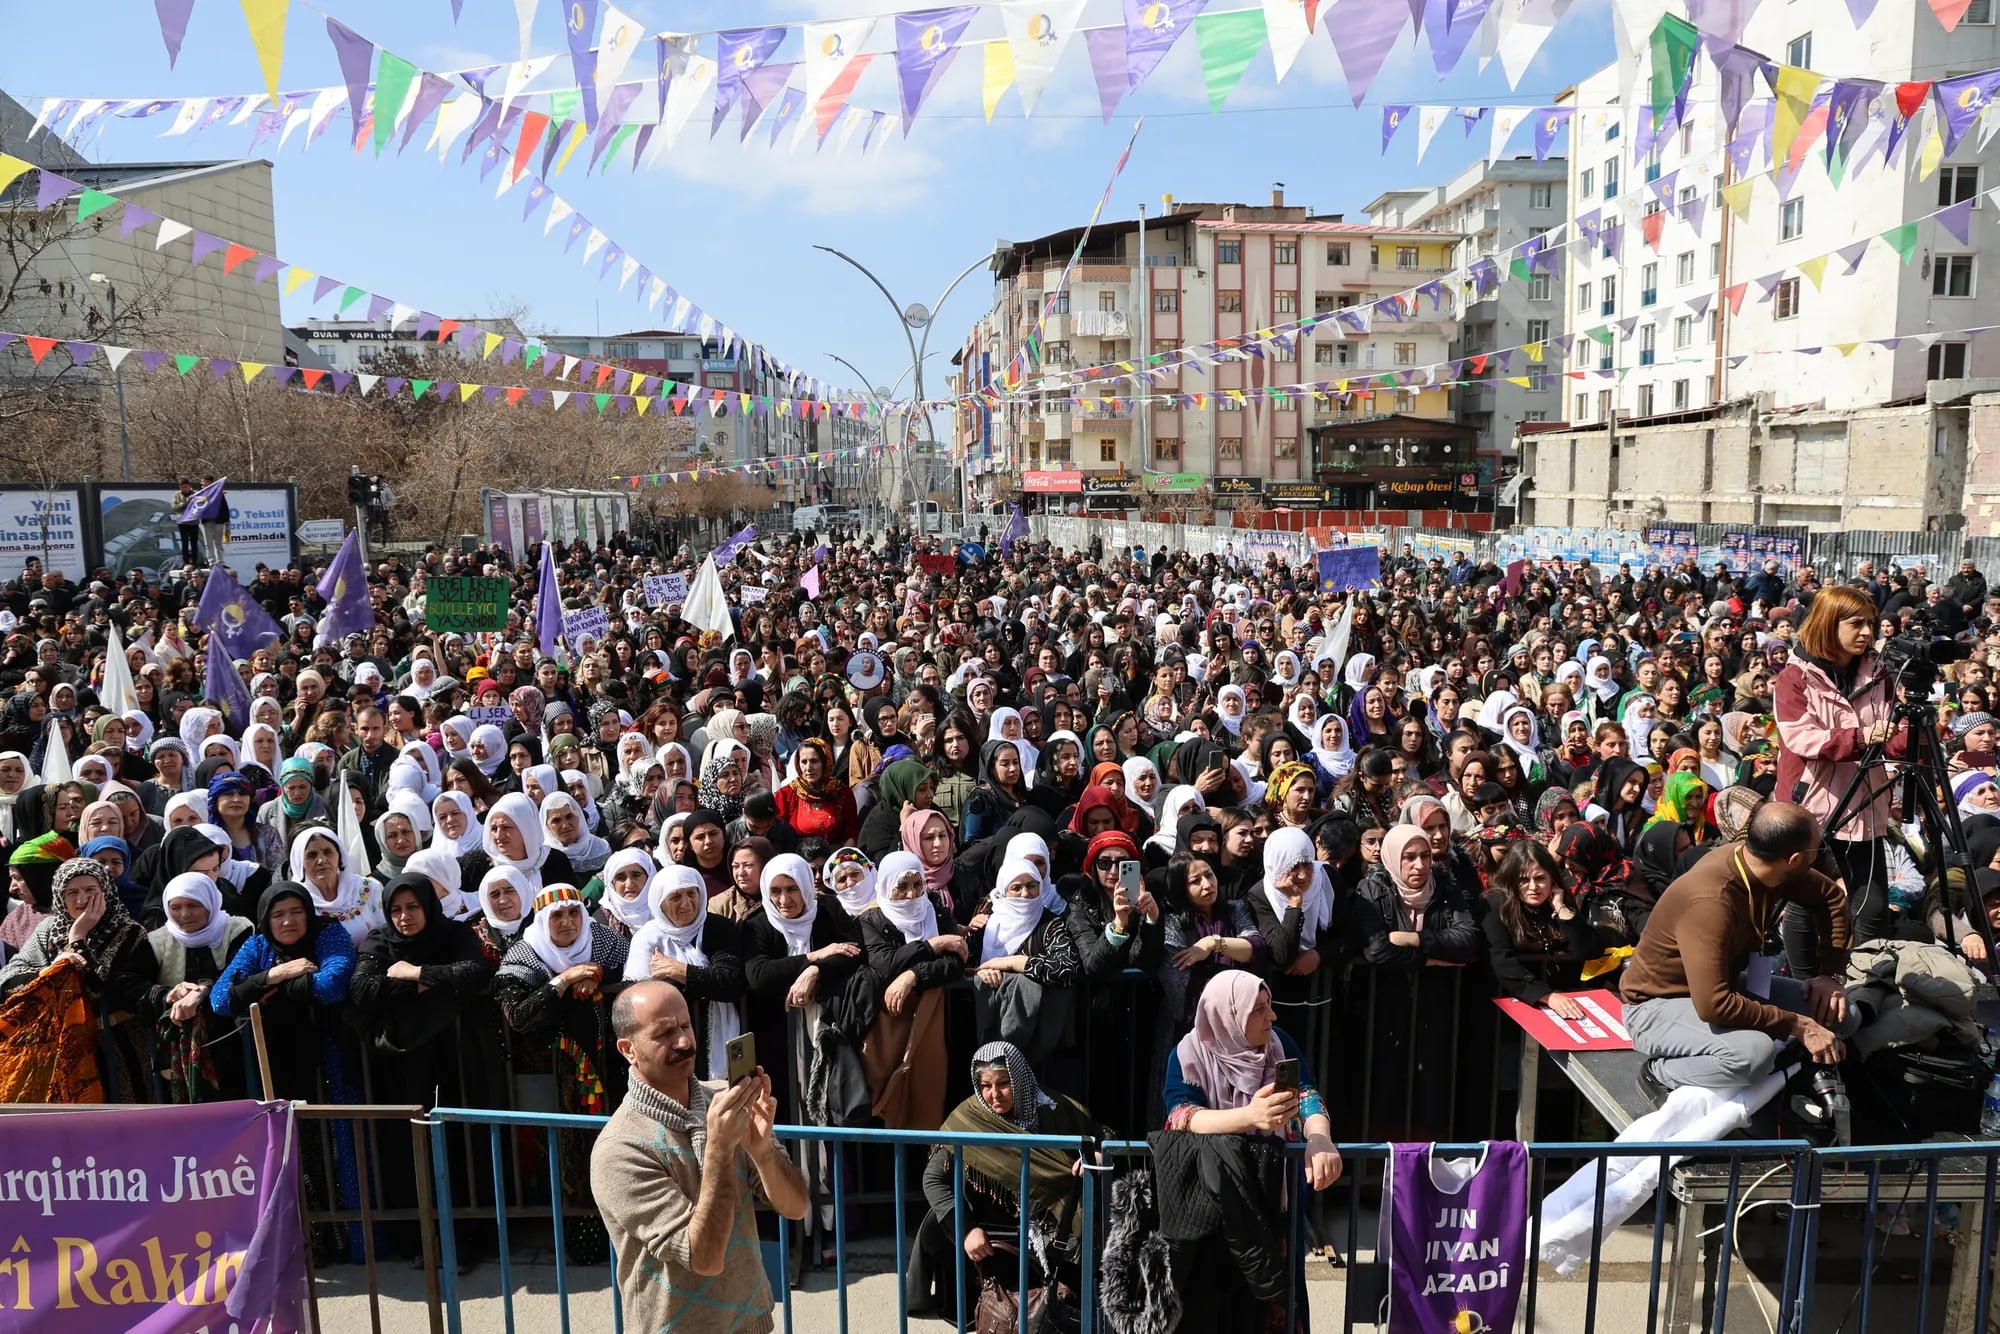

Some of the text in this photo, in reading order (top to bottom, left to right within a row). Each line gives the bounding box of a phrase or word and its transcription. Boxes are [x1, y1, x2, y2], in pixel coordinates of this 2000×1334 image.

[1390, 480, 1453, 493] Kebap Ötesi
[31, 499, 71, 511] Yeni
[244, 509, 284, 519] Tekstil
[0, 1153, 256, 1216] rqirina Jinê
[1435, 1208, 1477, 1230] JIN
[1425, 1237, 1500, 1264] JIYAN
[1421, 1262, 1510, 1296] AZADÎ
